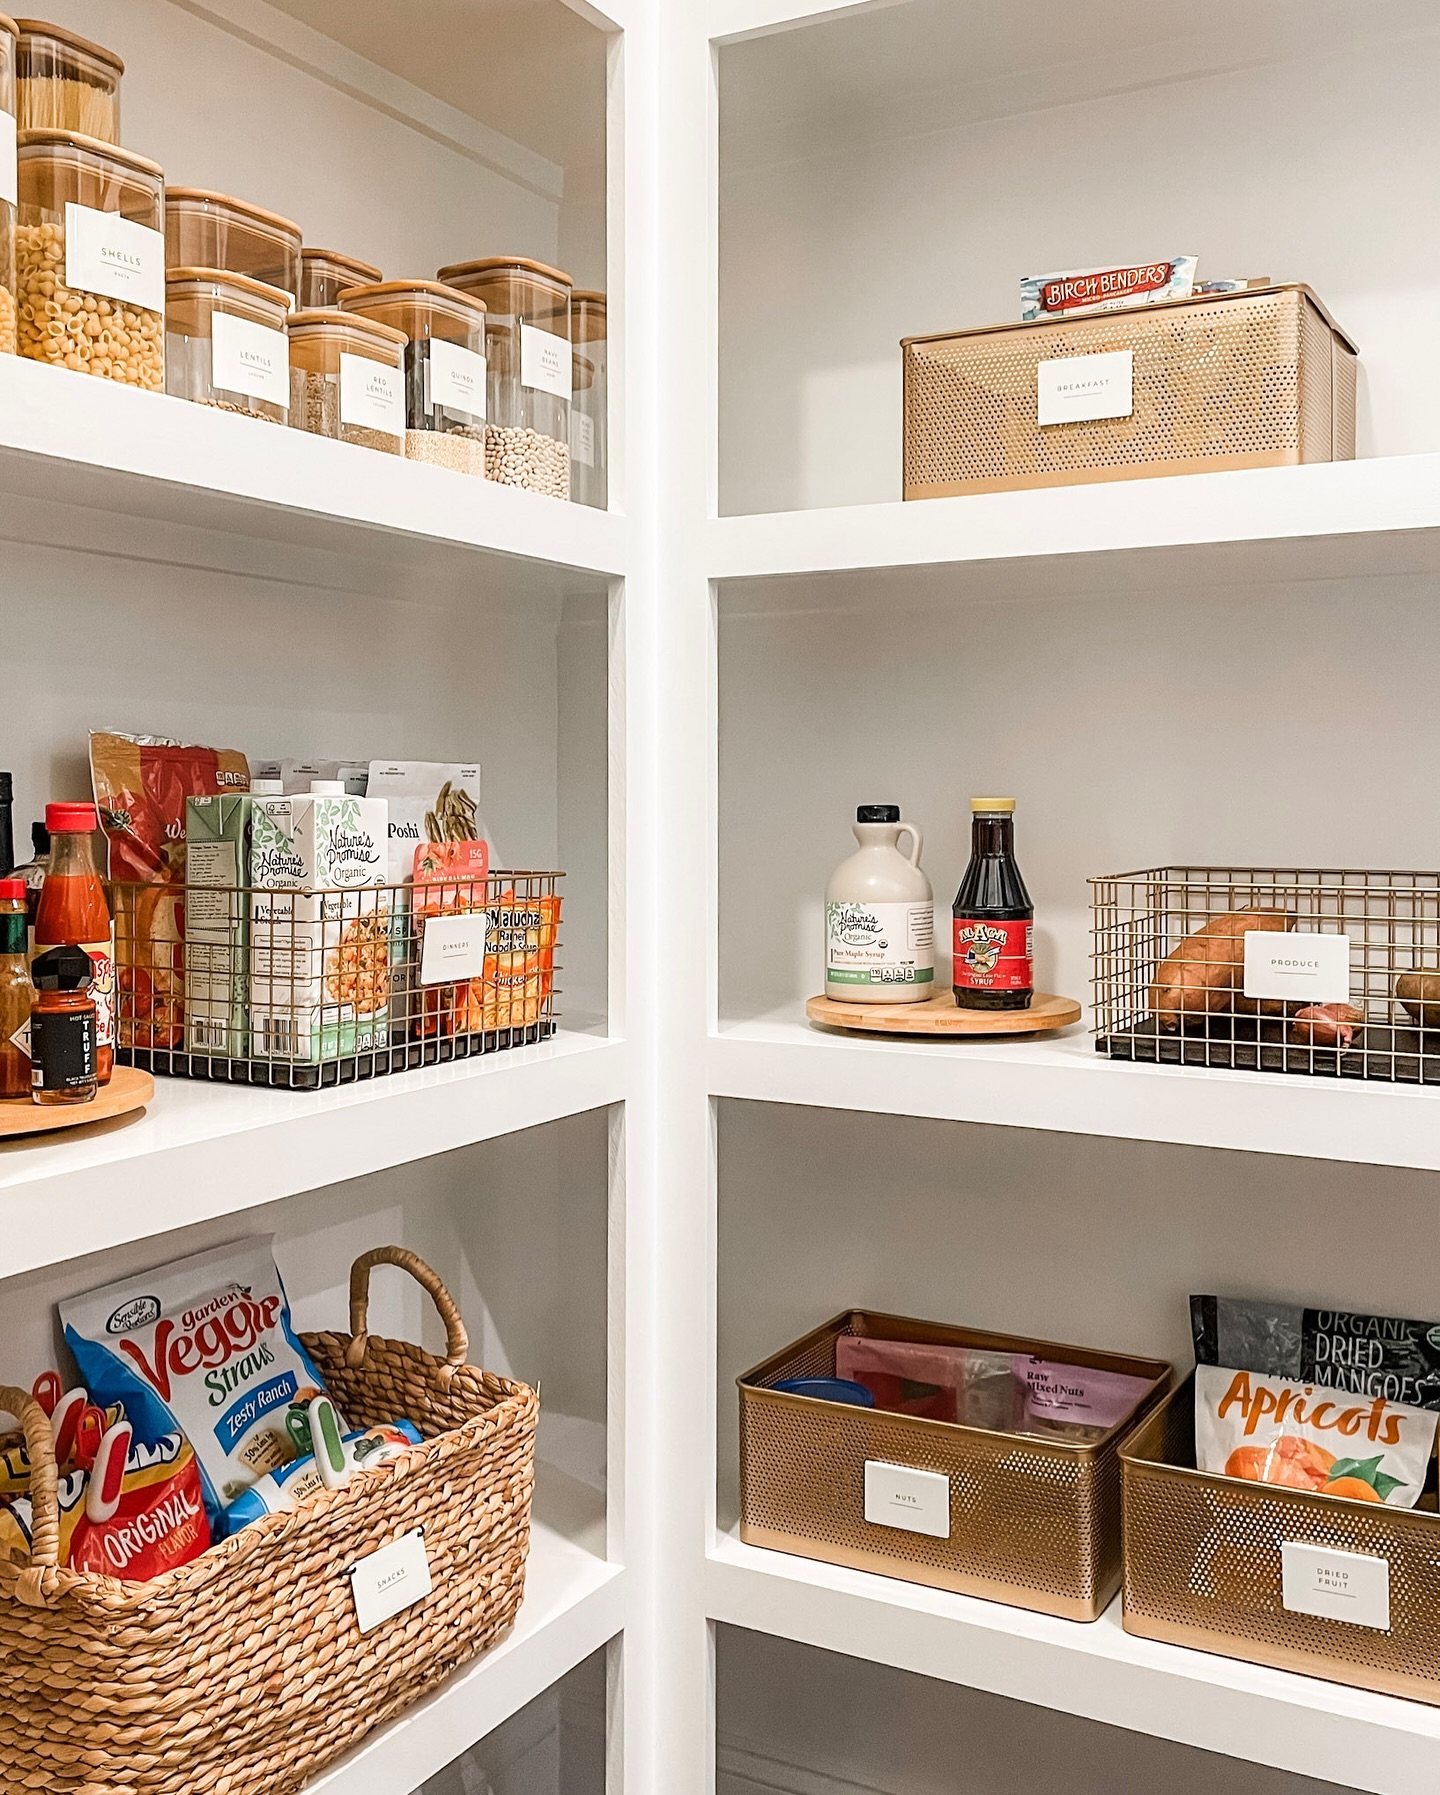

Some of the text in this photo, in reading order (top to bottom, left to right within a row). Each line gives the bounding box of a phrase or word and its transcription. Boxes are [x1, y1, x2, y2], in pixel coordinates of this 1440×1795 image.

[101, 247, 141, 266] SHELLS
[1046, 265, 1166, 306] BIRCH BENDERS
[240, 351, 271, 367] LENTILS
[541, 356, 559, 368] BEANS
[373, 376, 387, 386] RED
[450, 371, 474, 384] QUINOA
[1056, 379, 1109, 392] BREAKFAST
[366, 384, 393, 398] LENTILS
[329, 825, 374, 851] Nature's
[388, 822, 420, 840] Poshi
[260, 849, 304, 867] Nature's
[326, 847, 380, 873] Promise
[469, 848, 482, 859] 15G
[257, 863, 309, 882] Promise
[333, 865, 366, 882] Organic
[266, 878, 298, 888] Organic
[841, 909, 878, 924] Nature's
[839, 922, 883, 935] Promise
[844, 932, 872, 942] Organic
[442, 941, 469, 951] DINNERS
[845, 948, 864, 958] Maple
[865, 949, 885, 959] Syrup
[1271, 959, 1320, 968] PRODUCE
[970, 977, 994, 985] SYRUP
[69, 1014, 82, 1022] HOT
[82, 1020, 91, 1075] TRUFF
[113, 1300, 146, 1328] Sensible
[182, 1291, 239, 1331] garden
[119, 1295, 280, 1403] Veggie
[1315, 1333, 1384, 1369] DRIED
[204, 1341, 275, 1407] Straws
[1027, 1371, 1049, 1382] Raw
[1026, 1381, 1084, 1397] Mixed Nuts
[1314, 1364, 1428, 1405] MANGOES
[226, 1379, 292, 1439] Zesty Ranch
[1218, 1370, 1408, 1445] Apricots
[895, 1494, 917, 1503] NUTS
[104, 1489, 200, 1568] ORIGINAL
[158, 1524, 199, 1558] FLAVOR
[377, 1567, 406, 1589] SNACKS
[1317, 1567, 1349, 1579] DRIED
[1318, 1577, 1349, 1588] FRUIT
